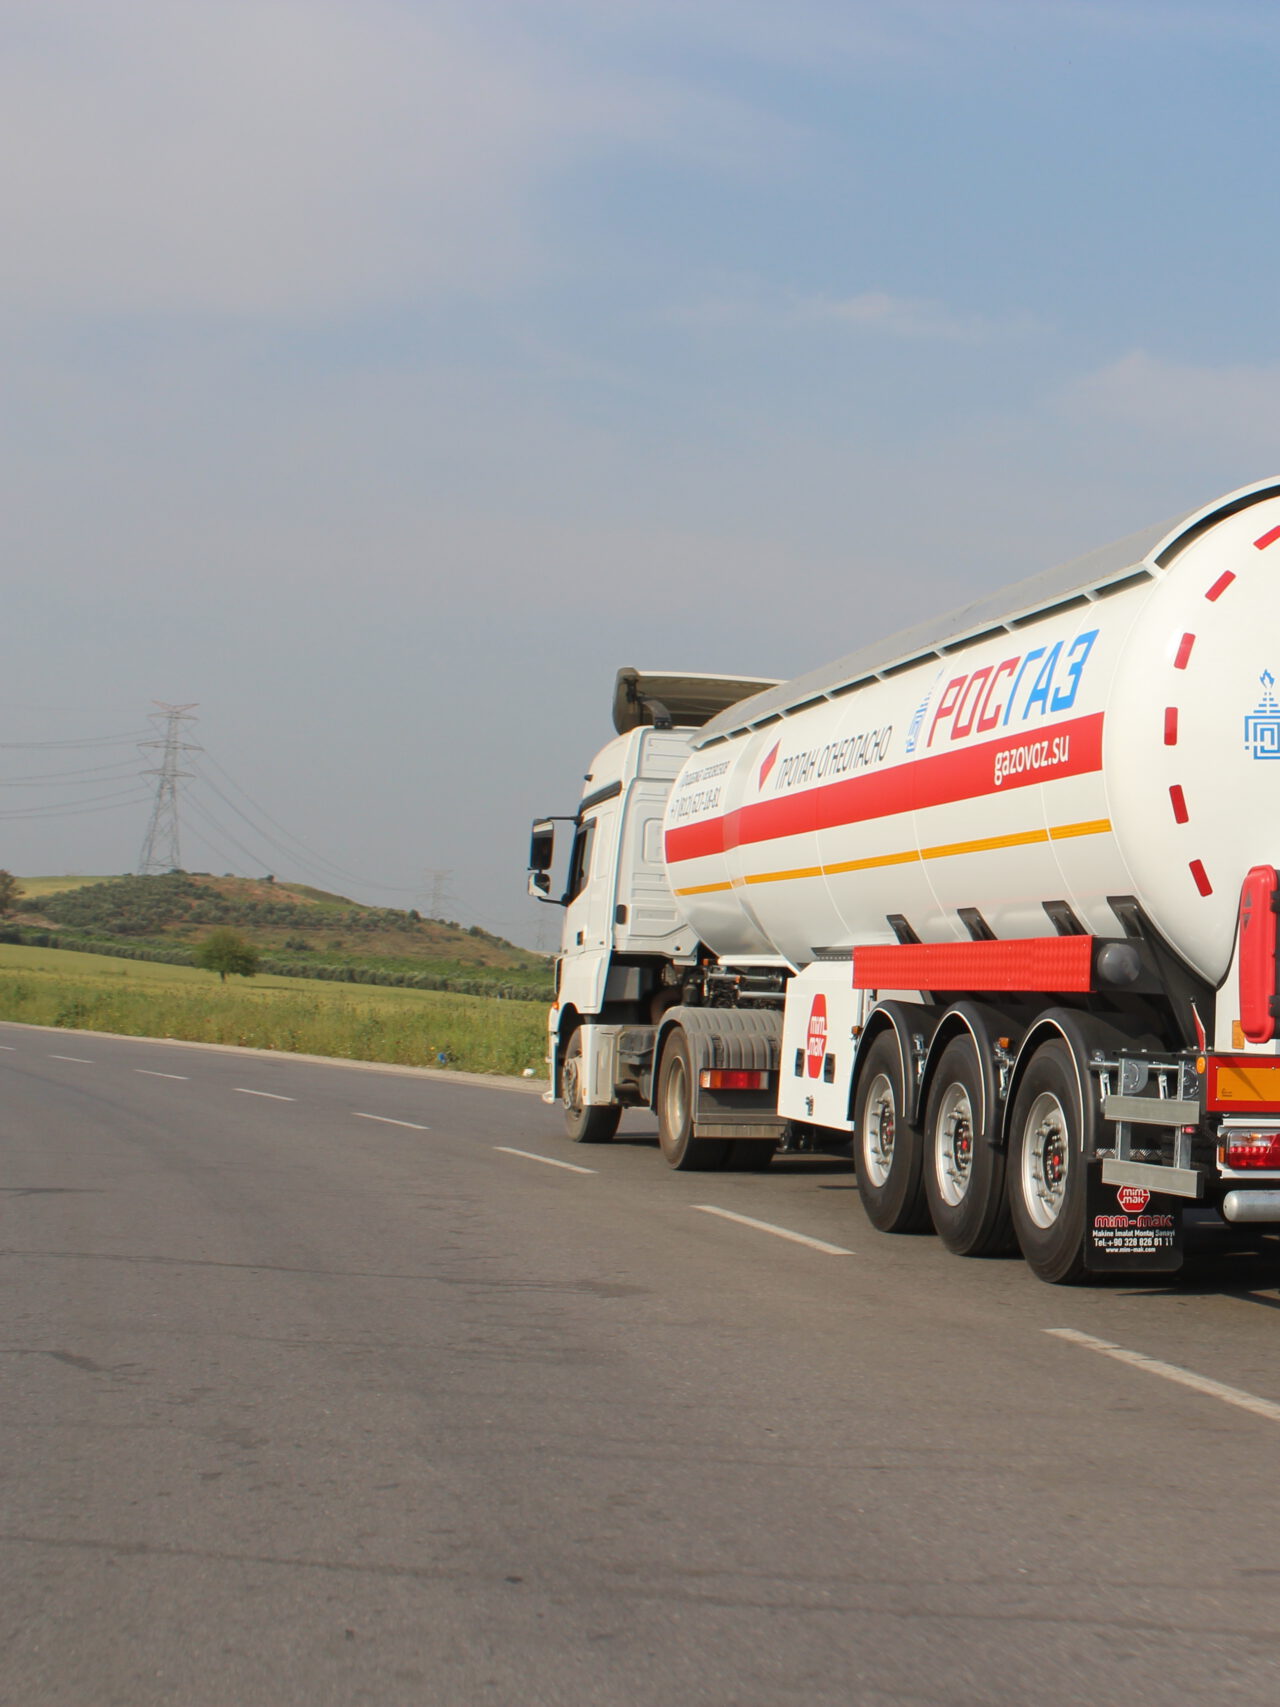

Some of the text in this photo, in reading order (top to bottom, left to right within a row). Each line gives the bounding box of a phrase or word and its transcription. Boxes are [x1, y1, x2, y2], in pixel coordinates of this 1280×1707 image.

[927, 629, 1100, 748] РОСГАЗ
[775, 748, 820, 790] ПРОПАН
[817, 725, 893, 778] ОГНЕОПАСНО
[994, 735, 1070, 786] gazovoz.su
[1122, 1196, 1145, 1204] mak
[1123, 1188, 1145, 1196] mim
[1094, 1215, 1172, 1228] mim-mak
